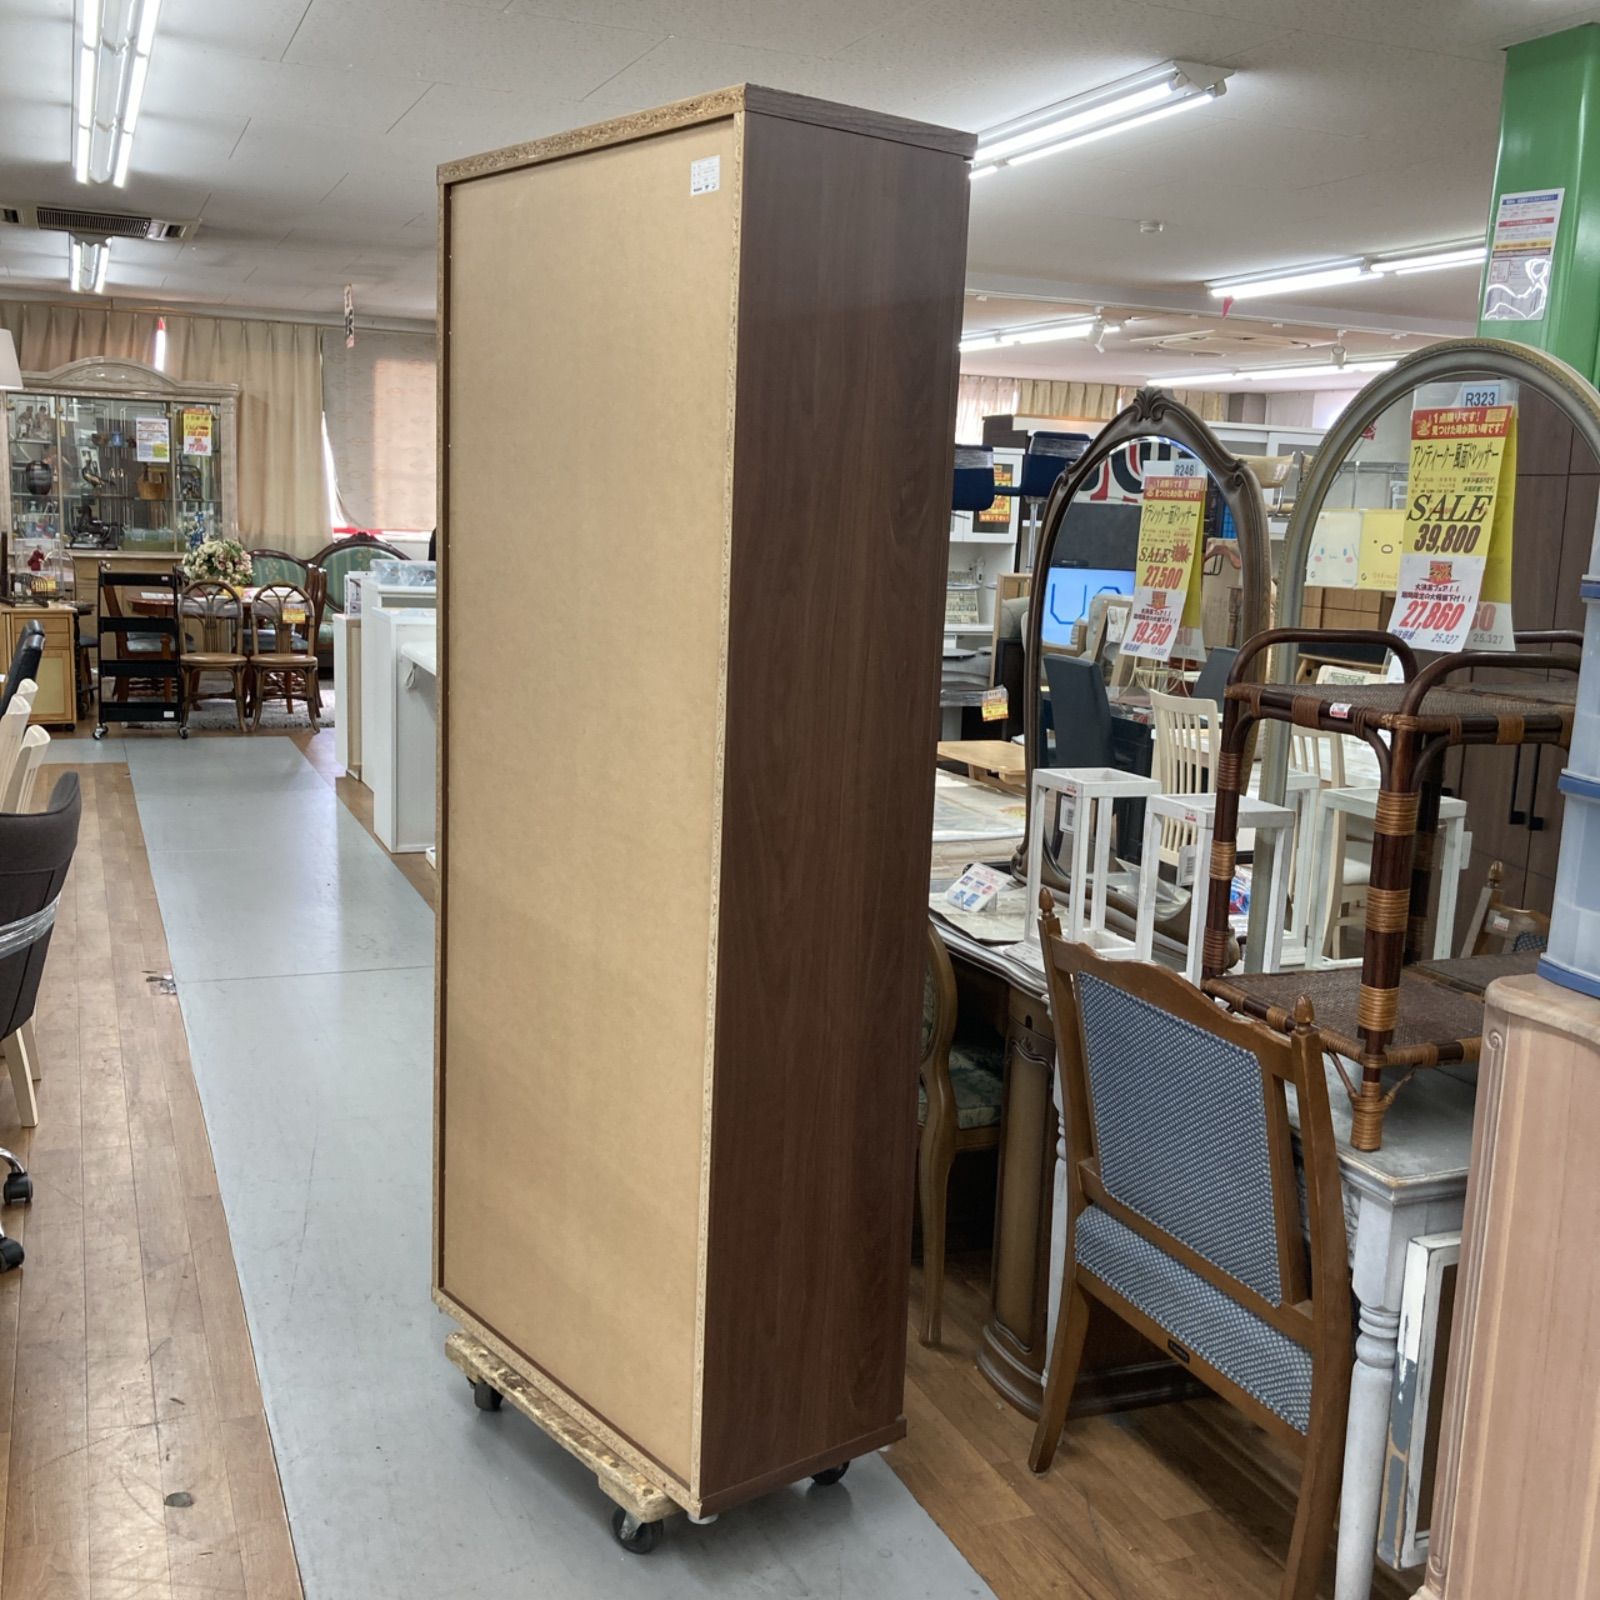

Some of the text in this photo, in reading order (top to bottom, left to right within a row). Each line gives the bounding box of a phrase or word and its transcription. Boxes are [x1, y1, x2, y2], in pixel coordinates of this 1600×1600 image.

[1465, 391, 1496, 407] R323
[1406, 494, 1493, 522] SALE
[1413, 523, 1482, 555] 39,800
[1142, 565, 1184, 590] 27,500
[1398, 600, 1466, 632] 27,860
[1131, 621, 1173, 646] 19,250
